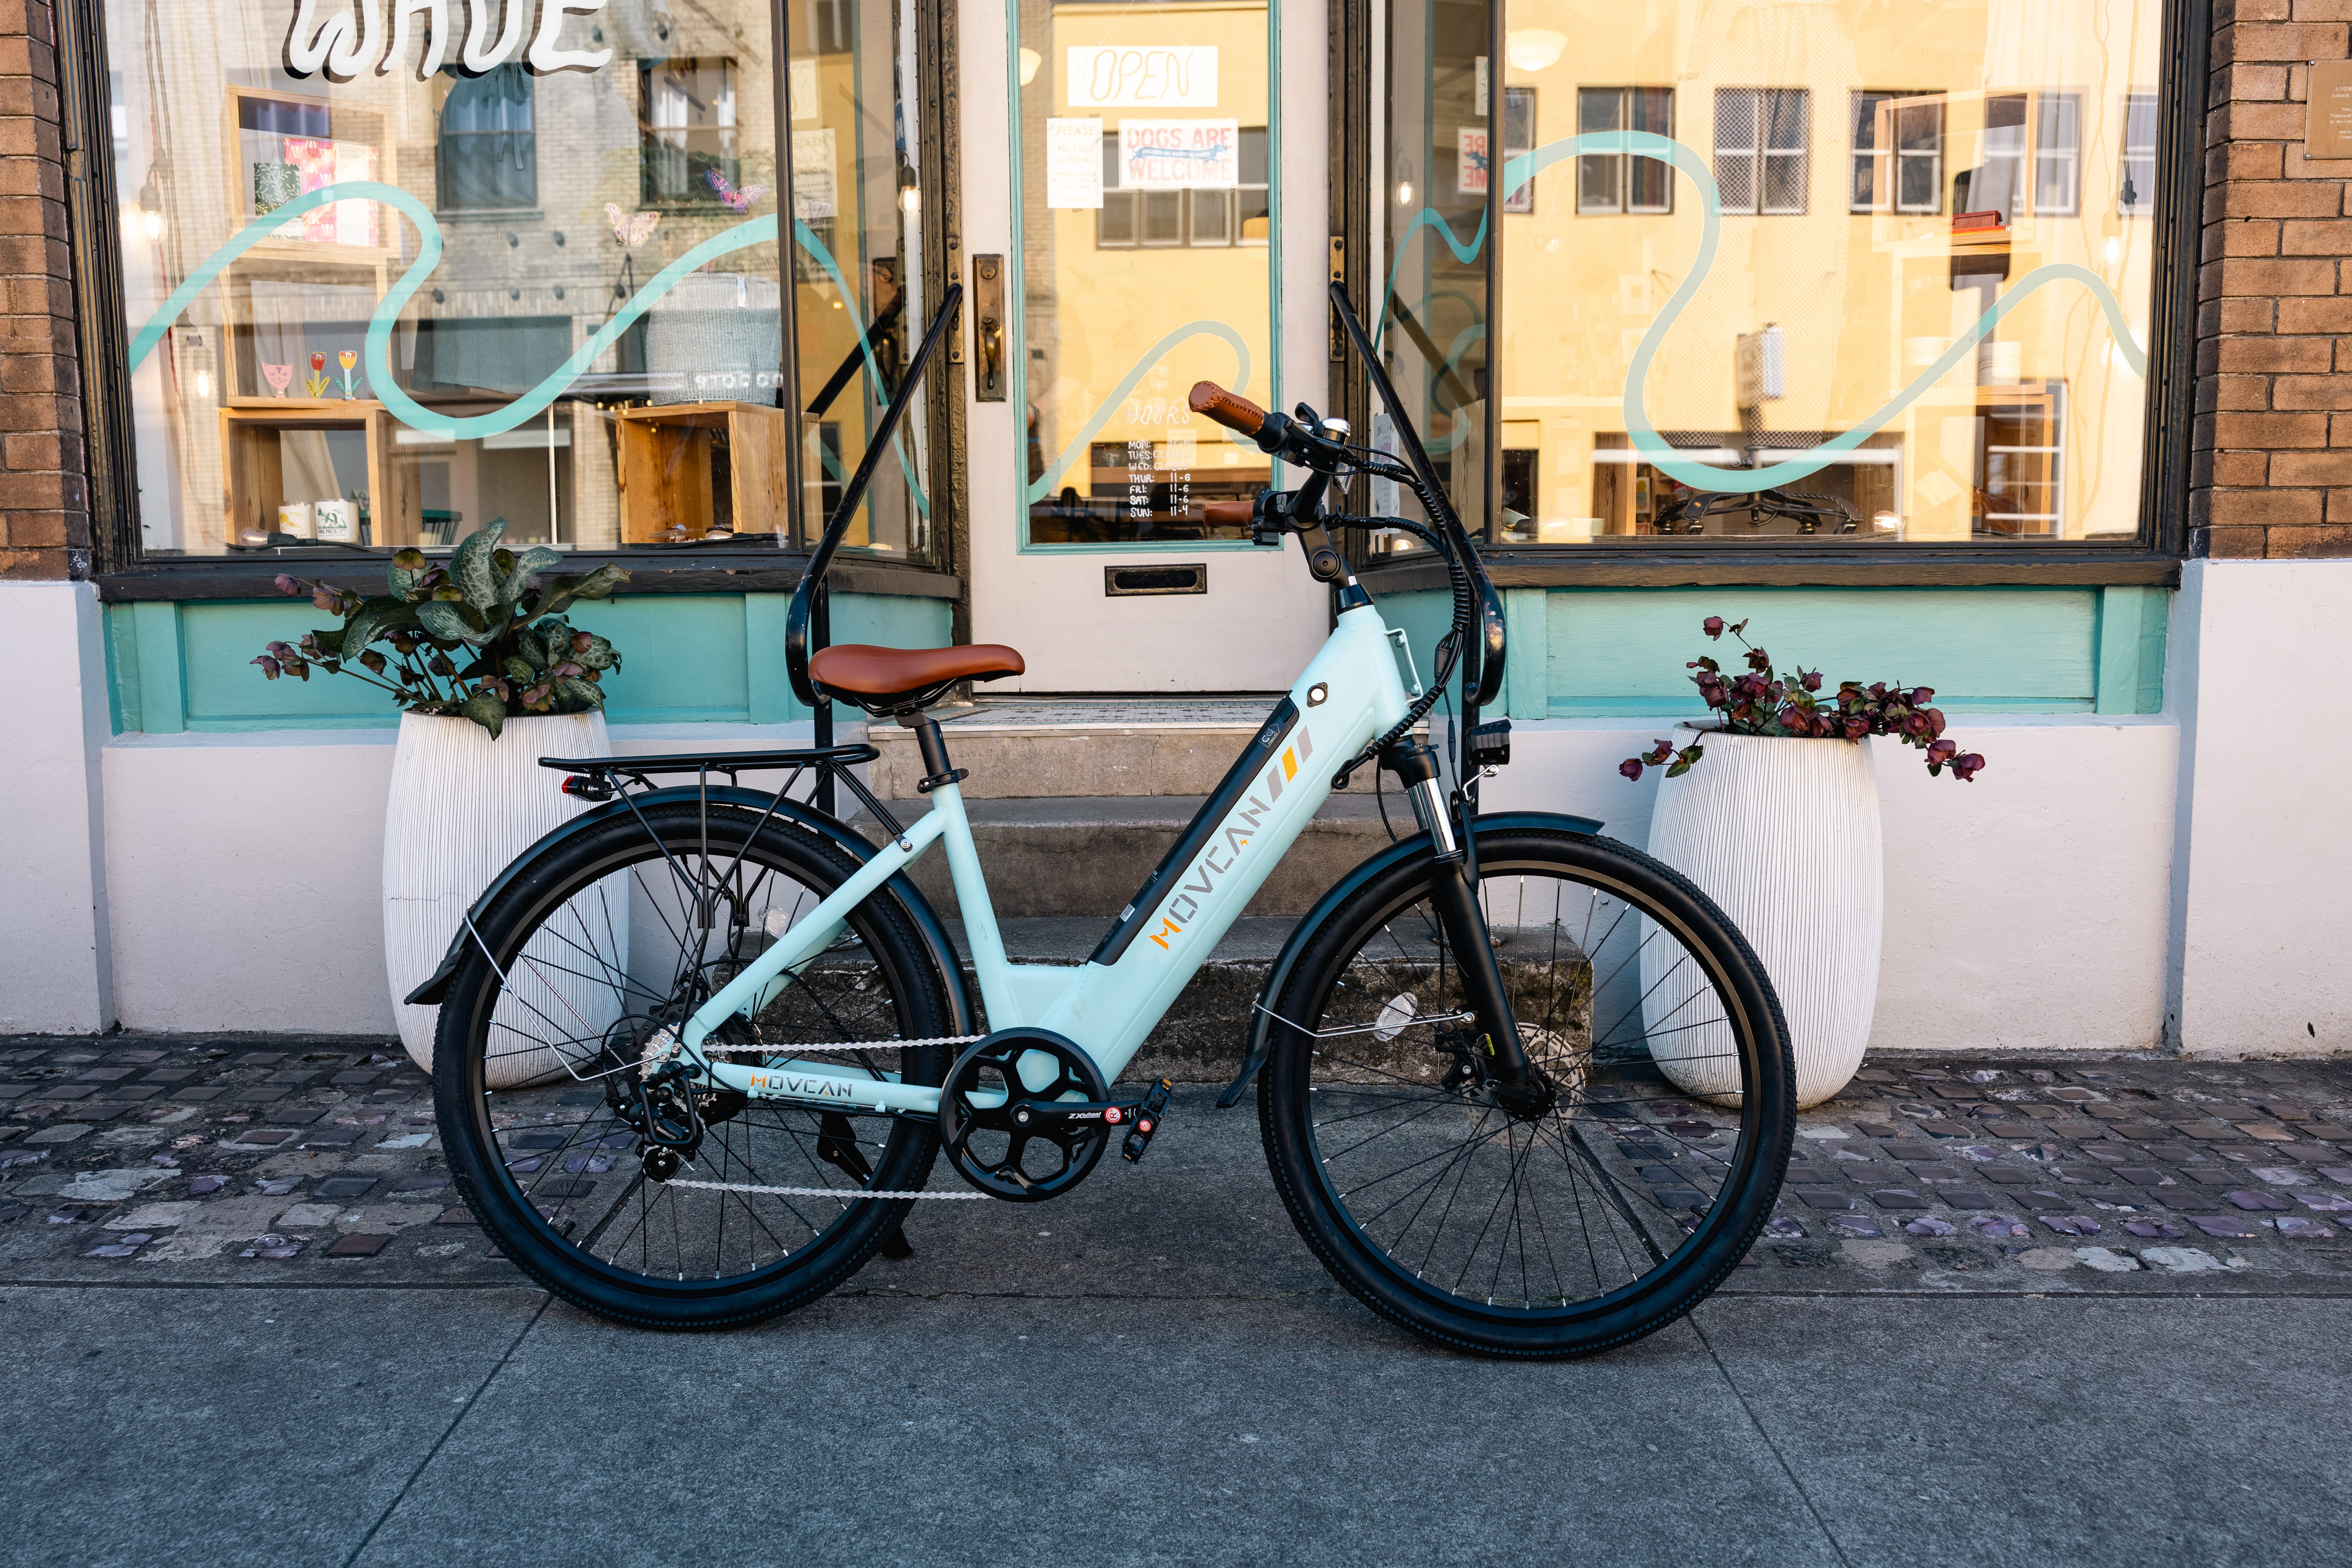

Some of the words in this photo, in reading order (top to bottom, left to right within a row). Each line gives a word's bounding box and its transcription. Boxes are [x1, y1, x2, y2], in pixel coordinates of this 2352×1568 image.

[1089, 49, 1195, 101] OPEN
[1056, 125, 1094, 136] PLEASE
[1127, 128, 1182, 149] DOGS
[1192, 128, 1232, 149] ARE
[1058, 145, 1070, 153] No
[1073, 144, 1093, 153] Food
[1069, 155, 1094, 164] Drinks
[1128, 158, 1232, 181] WELCOME
[1126, 405, 1190, 425] HOURS
[1128, 440, 1151, 450] MON:
[1127, 451, 1153, 460] TUES:
[1153, 449, 1189, 459] CLOSED
[1128, 462, 1152, 470] WED:
[1154, 462, 1189, 471] CLOSED
[1128, 474, 1155, 483] THUR:
[1129, 484, 1147, 494] FRI:
[1129, 495, 1149, 506] SAT:
[1130, 507, 1153, 518] SUN:
[1148, 795, 1271, 950] MOVCAN
[751, 1073, 852, 1098] MOVCAN
[655, 1126, 676, 1140] SHIMANO
